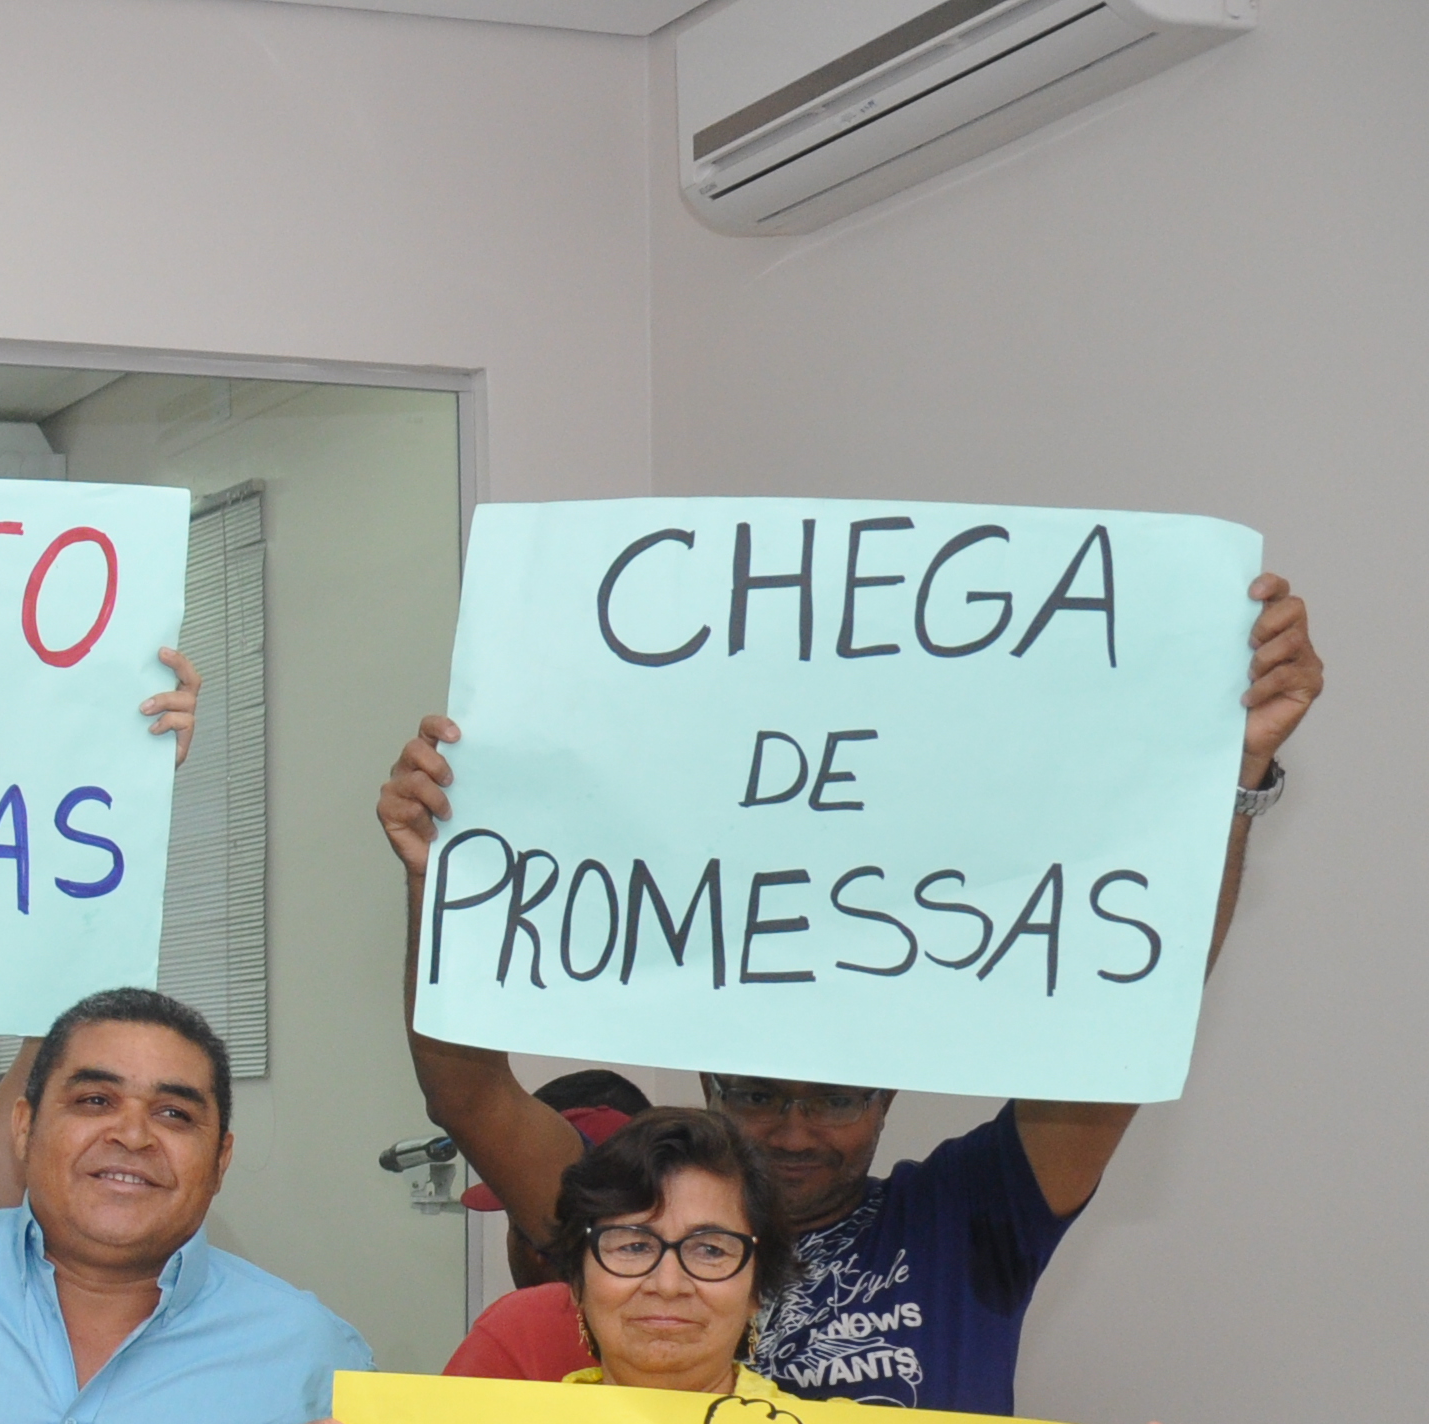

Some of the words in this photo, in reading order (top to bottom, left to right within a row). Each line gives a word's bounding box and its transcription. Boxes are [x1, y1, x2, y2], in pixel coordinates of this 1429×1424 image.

[597, 516, 1117, 668] CHEGA
[739, 729, 878, 811] DE
[429, 829, 1162, 996] PROMESSAS
[787, 1347, 918, 1388] WANTS
